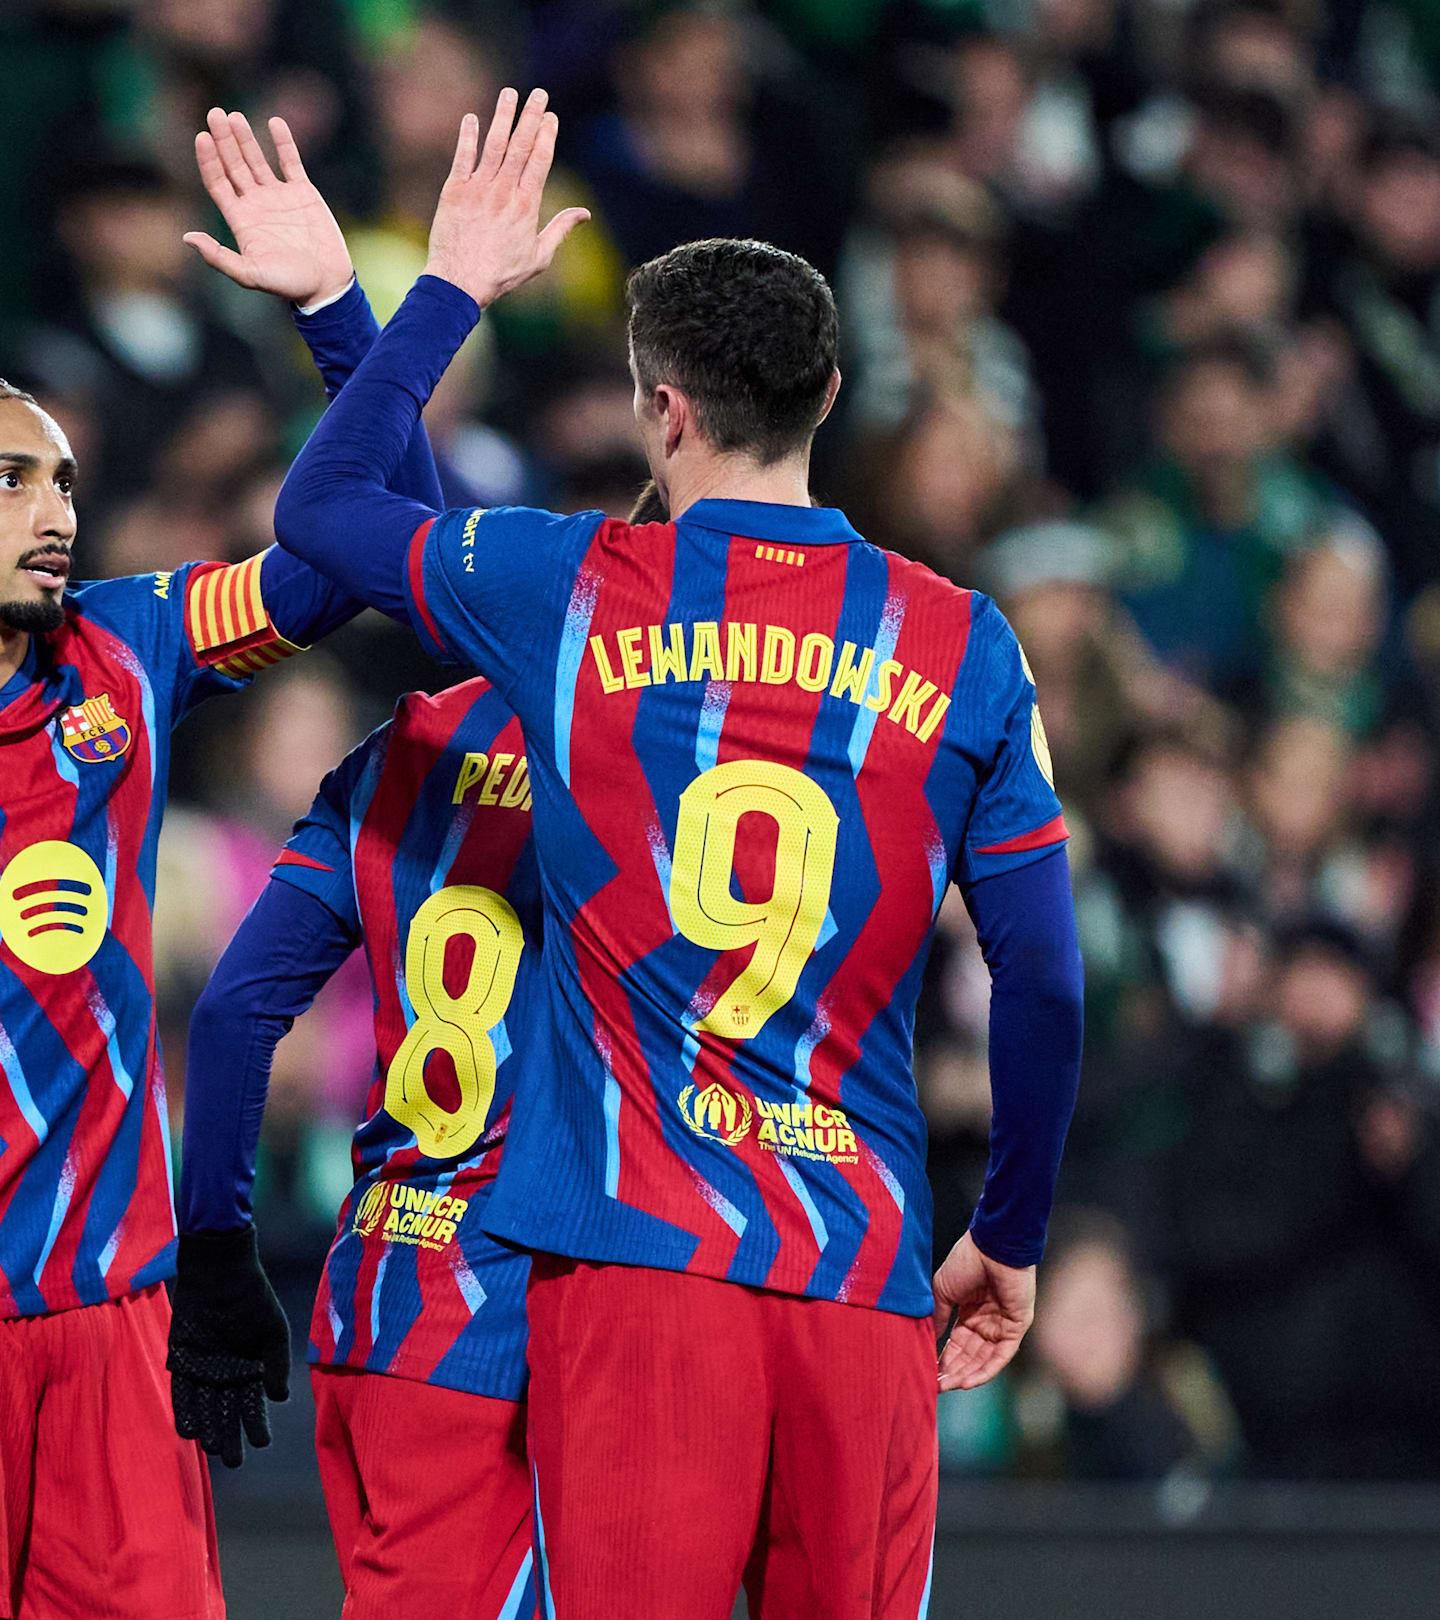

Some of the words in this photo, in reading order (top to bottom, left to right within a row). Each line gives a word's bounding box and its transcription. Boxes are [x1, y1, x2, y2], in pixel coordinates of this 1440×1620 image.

[153, 571, 172, 600] AM
[589, 621, 952, 743] LEWANDOWSKI
[81, 725, 106, 740] FCB
[452, 752, 533, 812] PED
[669, 759, 841, 1039] 9
[384, 884, 525, 1159] 8
[754, 1096, 852, 1130] UNHCR
[757, 1119, 858, 1153] ACNUR
[758, 1141, 775, 1152] The
[776, 1145, 792, 1156] UN
[793, 1147, 825, 1161] Refugee
[826, 1153, 859, 1165] Agency
[389, 1183, 468, 1222] UNHCR
[383, 1208, 458, 1244] ACNUR
